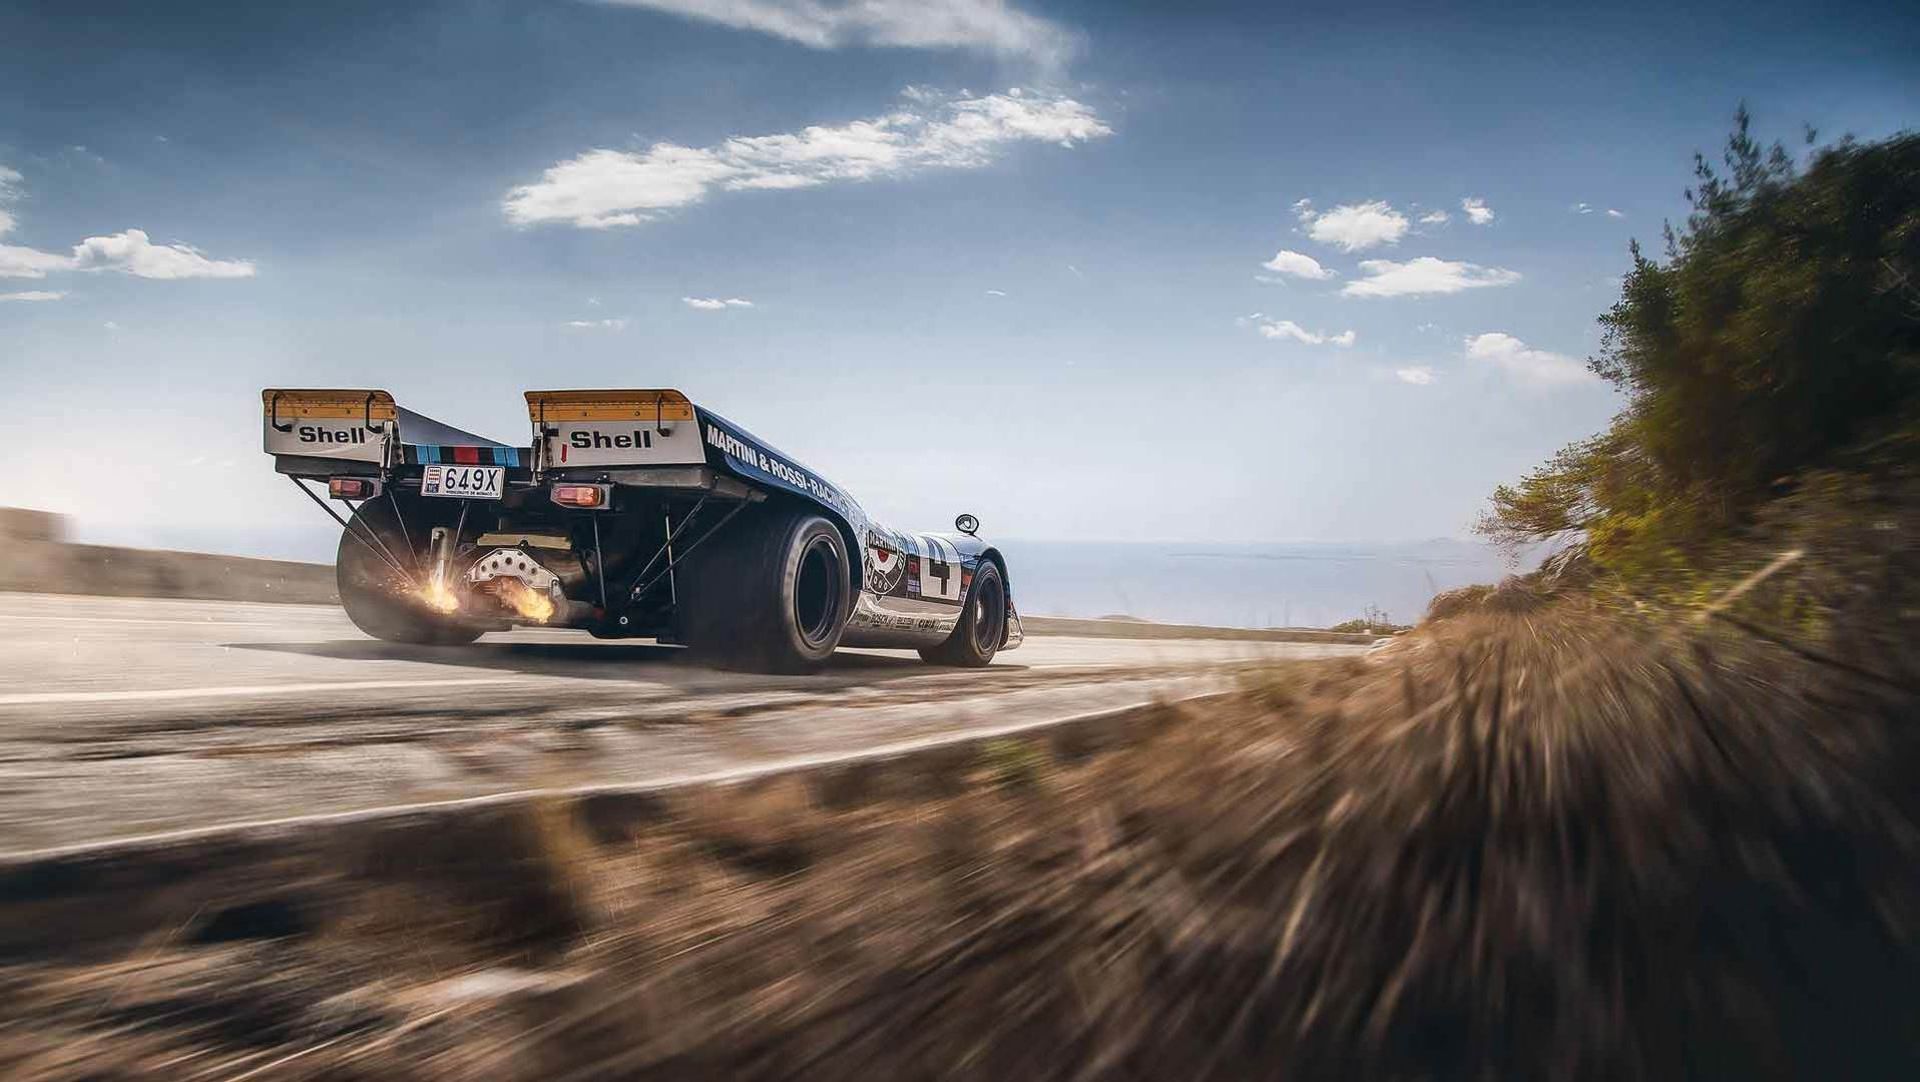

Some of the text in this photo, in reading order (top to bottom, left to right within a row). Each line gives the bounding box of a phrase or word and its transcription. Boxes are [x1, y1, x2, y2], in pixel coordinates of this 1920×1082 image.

[299, 426, 365, 444] Shell
[570, 430, 651, 449] Shell
[707, 424, 758, 466] MARTINI
[759, 453, 771, 473] &
[445, 468, 498, 491] 649X
[928, 541, 950, 595] 4
